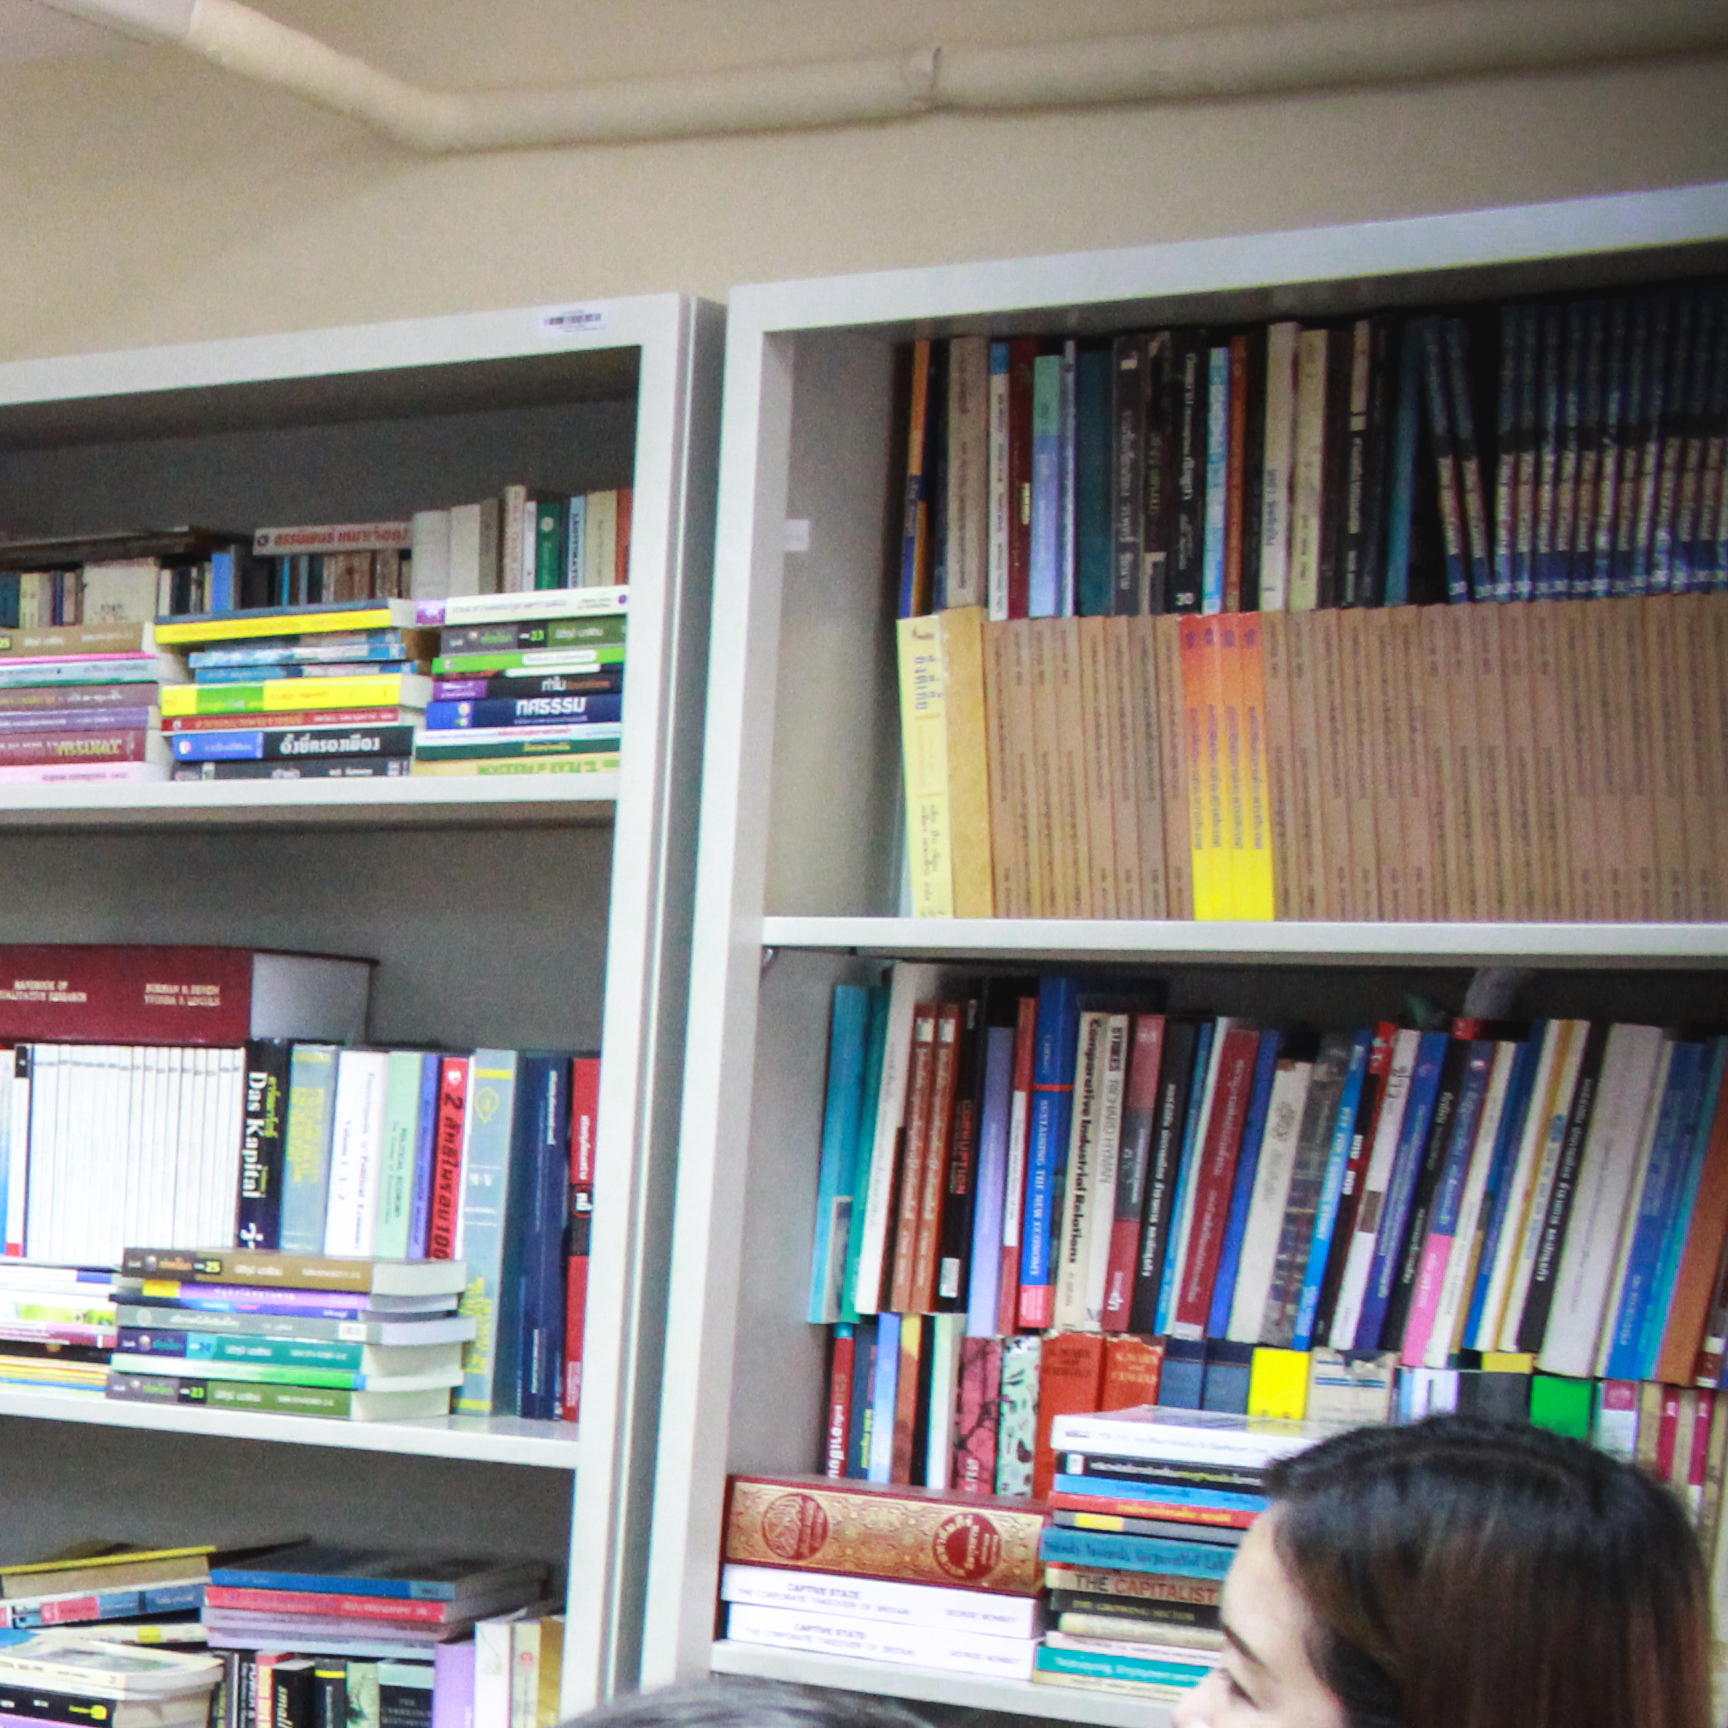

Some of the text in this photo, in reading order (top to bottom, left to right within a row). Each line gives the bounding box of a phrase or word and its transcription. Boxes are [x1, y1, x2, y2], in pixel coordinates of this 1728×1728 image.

[242, 1072, 268, 1198] Das Kapital
[445, 1093, 463, 1110] 2
[1067, 1018, 1102, 1264] Comparative Industrial Relations
[1075, 1573, 1217, 1605] THE CAPITALIST
